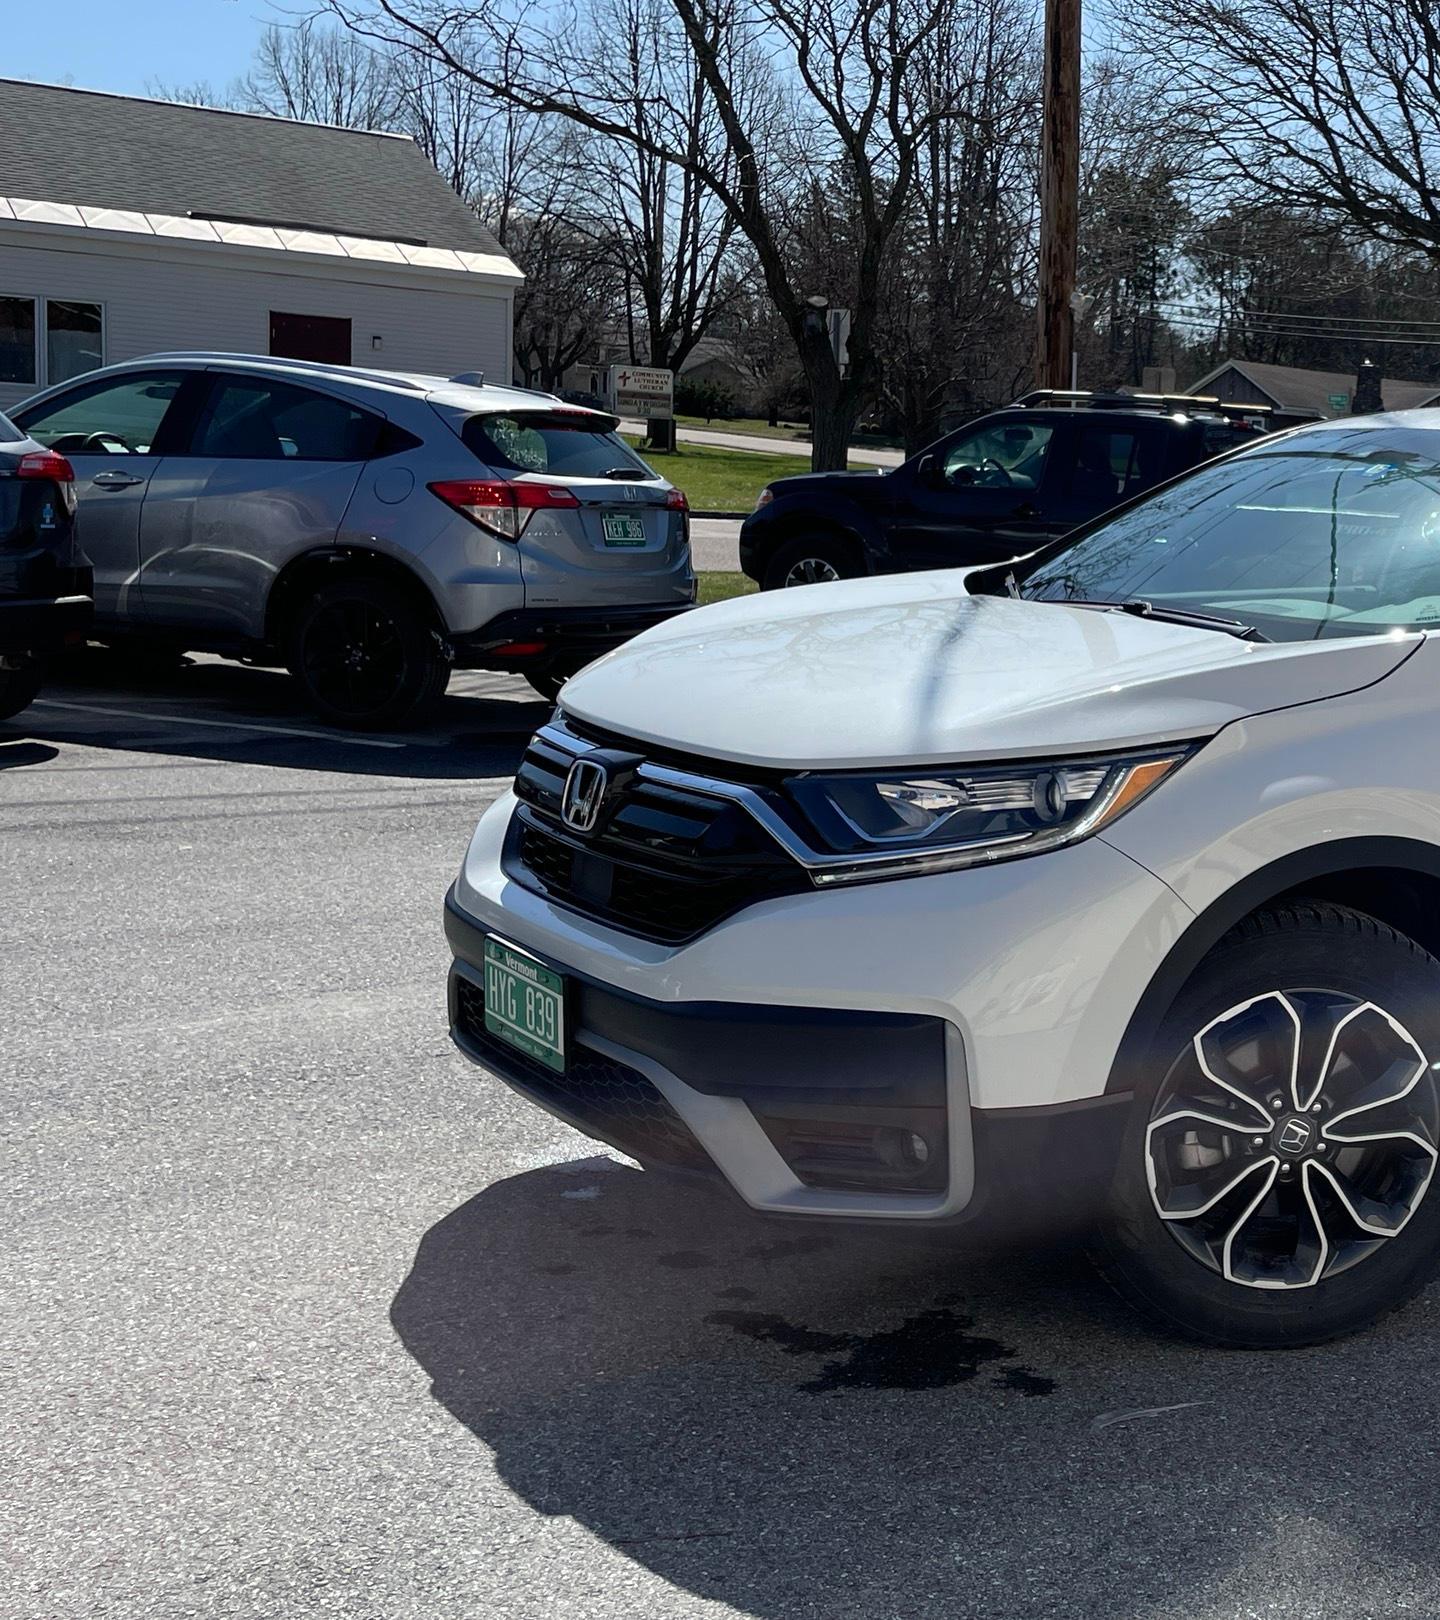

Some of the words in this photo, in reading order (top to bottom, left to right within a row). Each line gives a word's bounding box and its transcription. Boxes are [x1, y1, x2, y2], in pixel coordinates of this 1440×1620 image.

[632, 371, 670, 379] COMMUNITY
[607, 521, 623, 538] KEH
[505, 952, 538, 981] Vermont
[490, 966, 516, 1021] HYG
[526, 986, 554, 1042] 839
